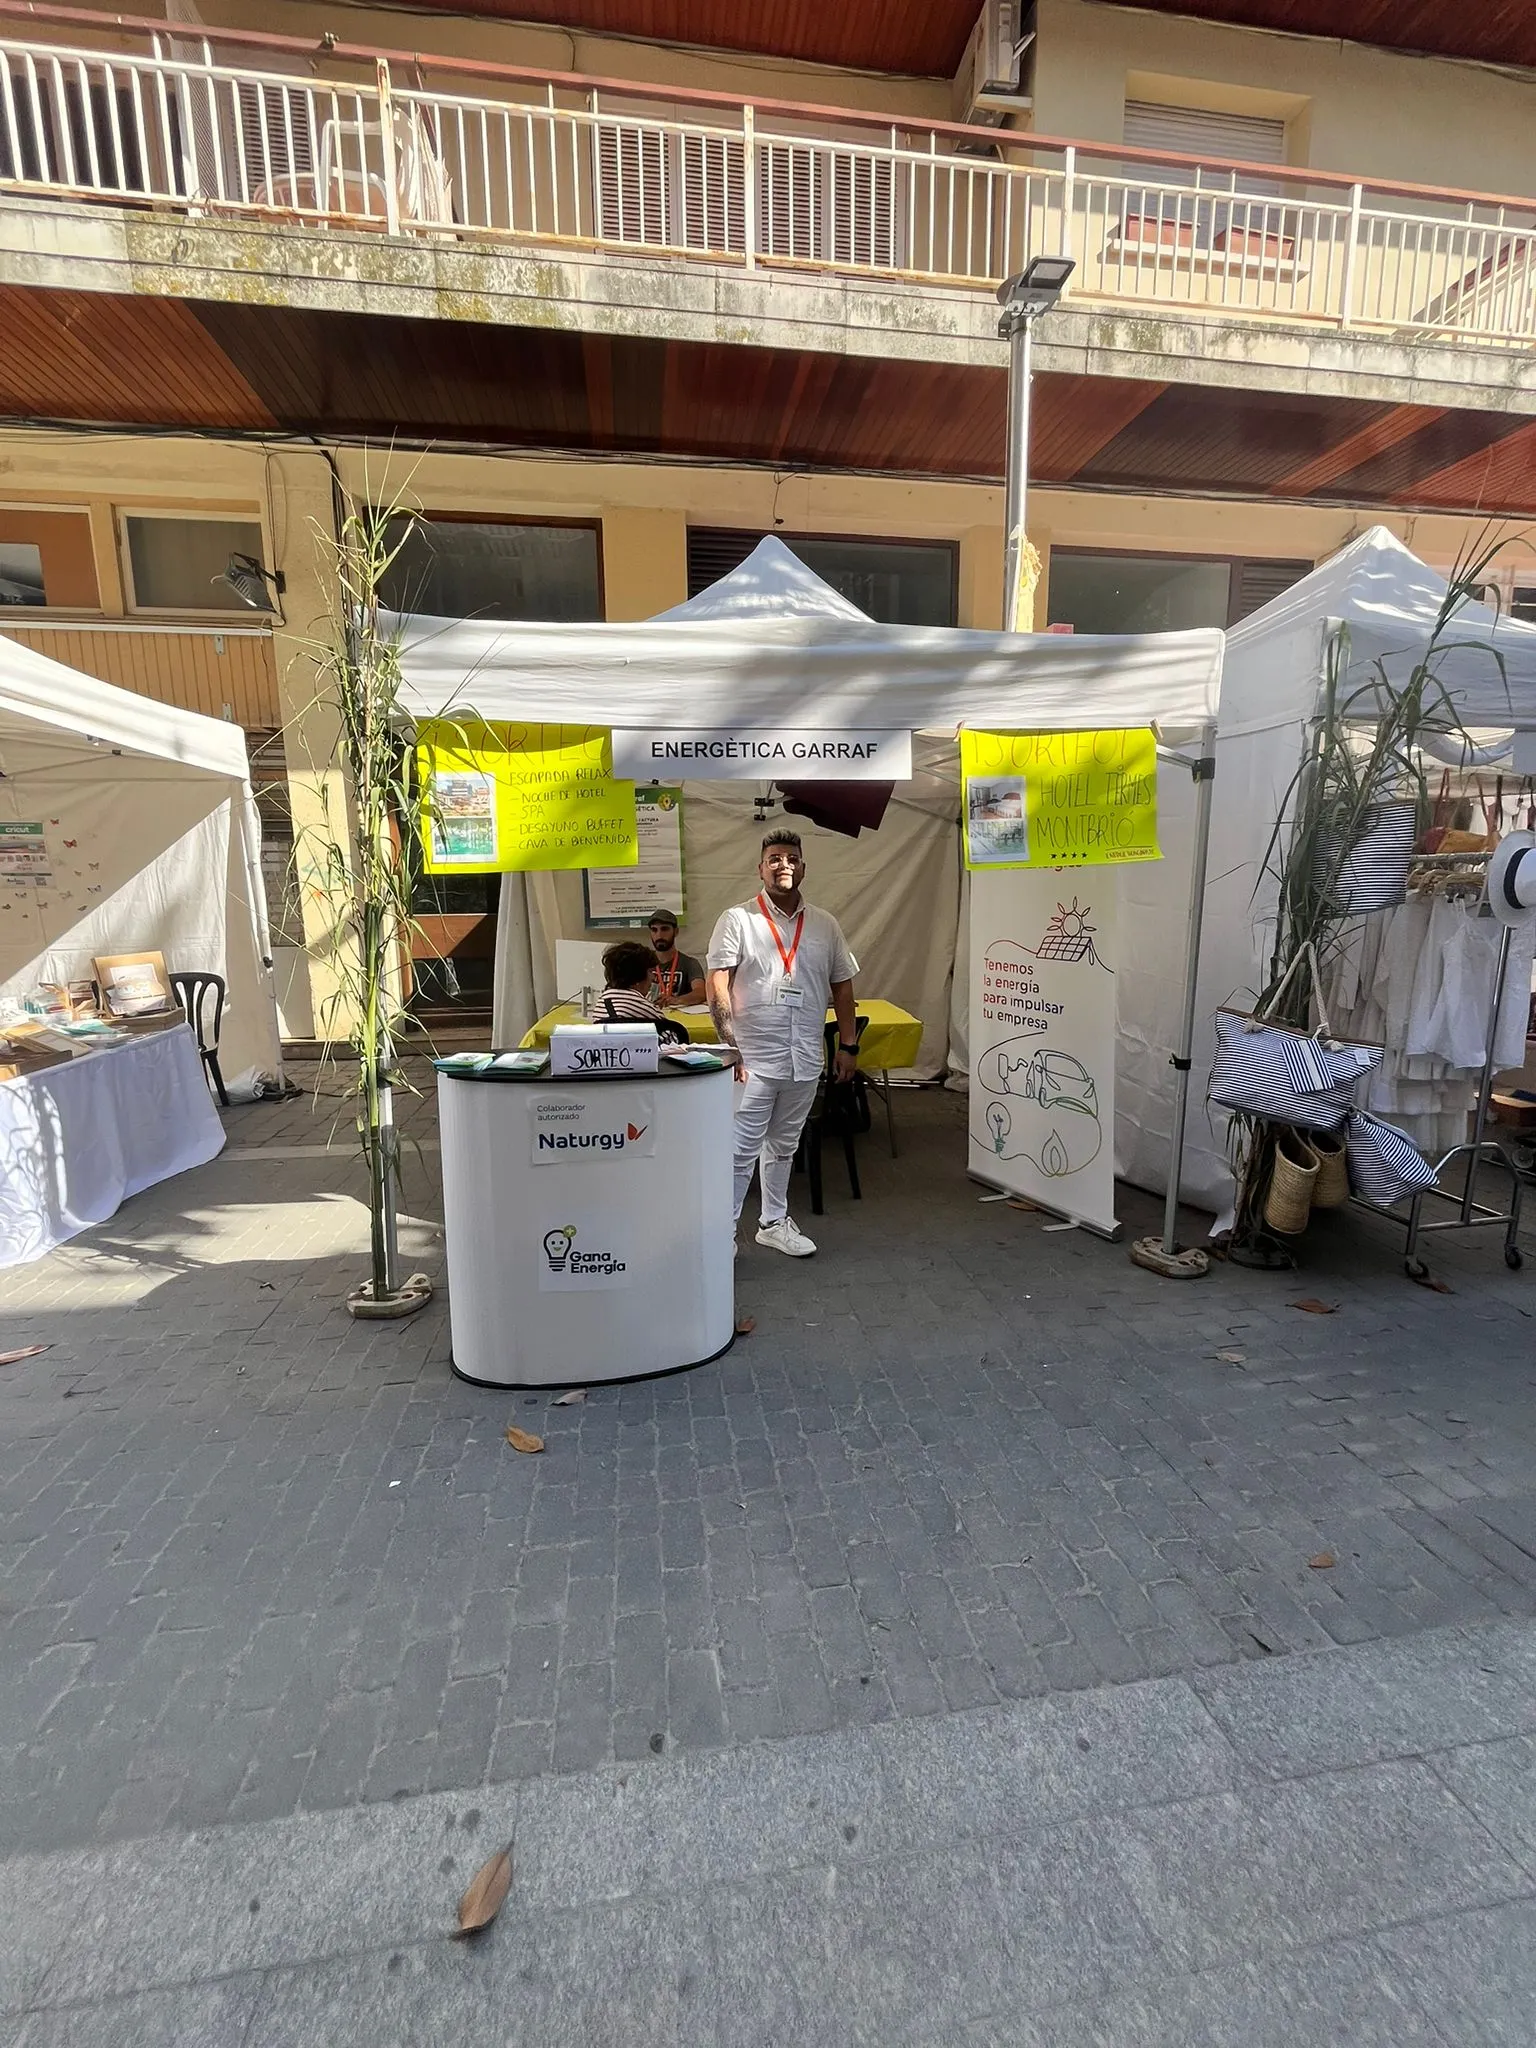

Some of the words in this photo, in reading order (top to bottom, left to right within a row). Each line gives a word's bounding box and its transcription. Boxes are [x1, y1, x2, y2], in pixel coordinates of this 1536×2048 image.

[651, 738, 786, 758] ENERGÈTICA
[792, 743, 878, 759] GARRAF
[509, 769, 570, 786] ESCAPADA
[576, 767, 612, 781] RELAX
[521, 790, 556, 803] NOCHE
[559, 789, 570, 801] DE
[576, 787, 607, 800] HOTEL
[1040, 772, 1096, 809] HOTEL
[521, 804, 546, 819] SPA
[519, 821, 579, 835] DESAYUNO
[586, 818, 625, 832] BUFFET
[518, 838, 549, 850] CAVA
[554, 837, 566, 848] DE
[984, 957, 1034, 975] Tenemos
[983, 974, 991, 986] la
[995, 978, 1040, 994] energía
[983, 993, 1008, 1006] para
[1010, 994, 1064, 1015] impulsar
[983, 1007, 993, 1019] tu
[997, 1011, 1048, 1030] empresa
[567, 1047, 631, 1070] SORTEO
[537, 1104, 586, 1113] Colaborador
[537, 1113, 580, 1121] autorizado
[538, 1132, 625, 1150] Naturgy
[570, 1251, 611, 1262] Gana
